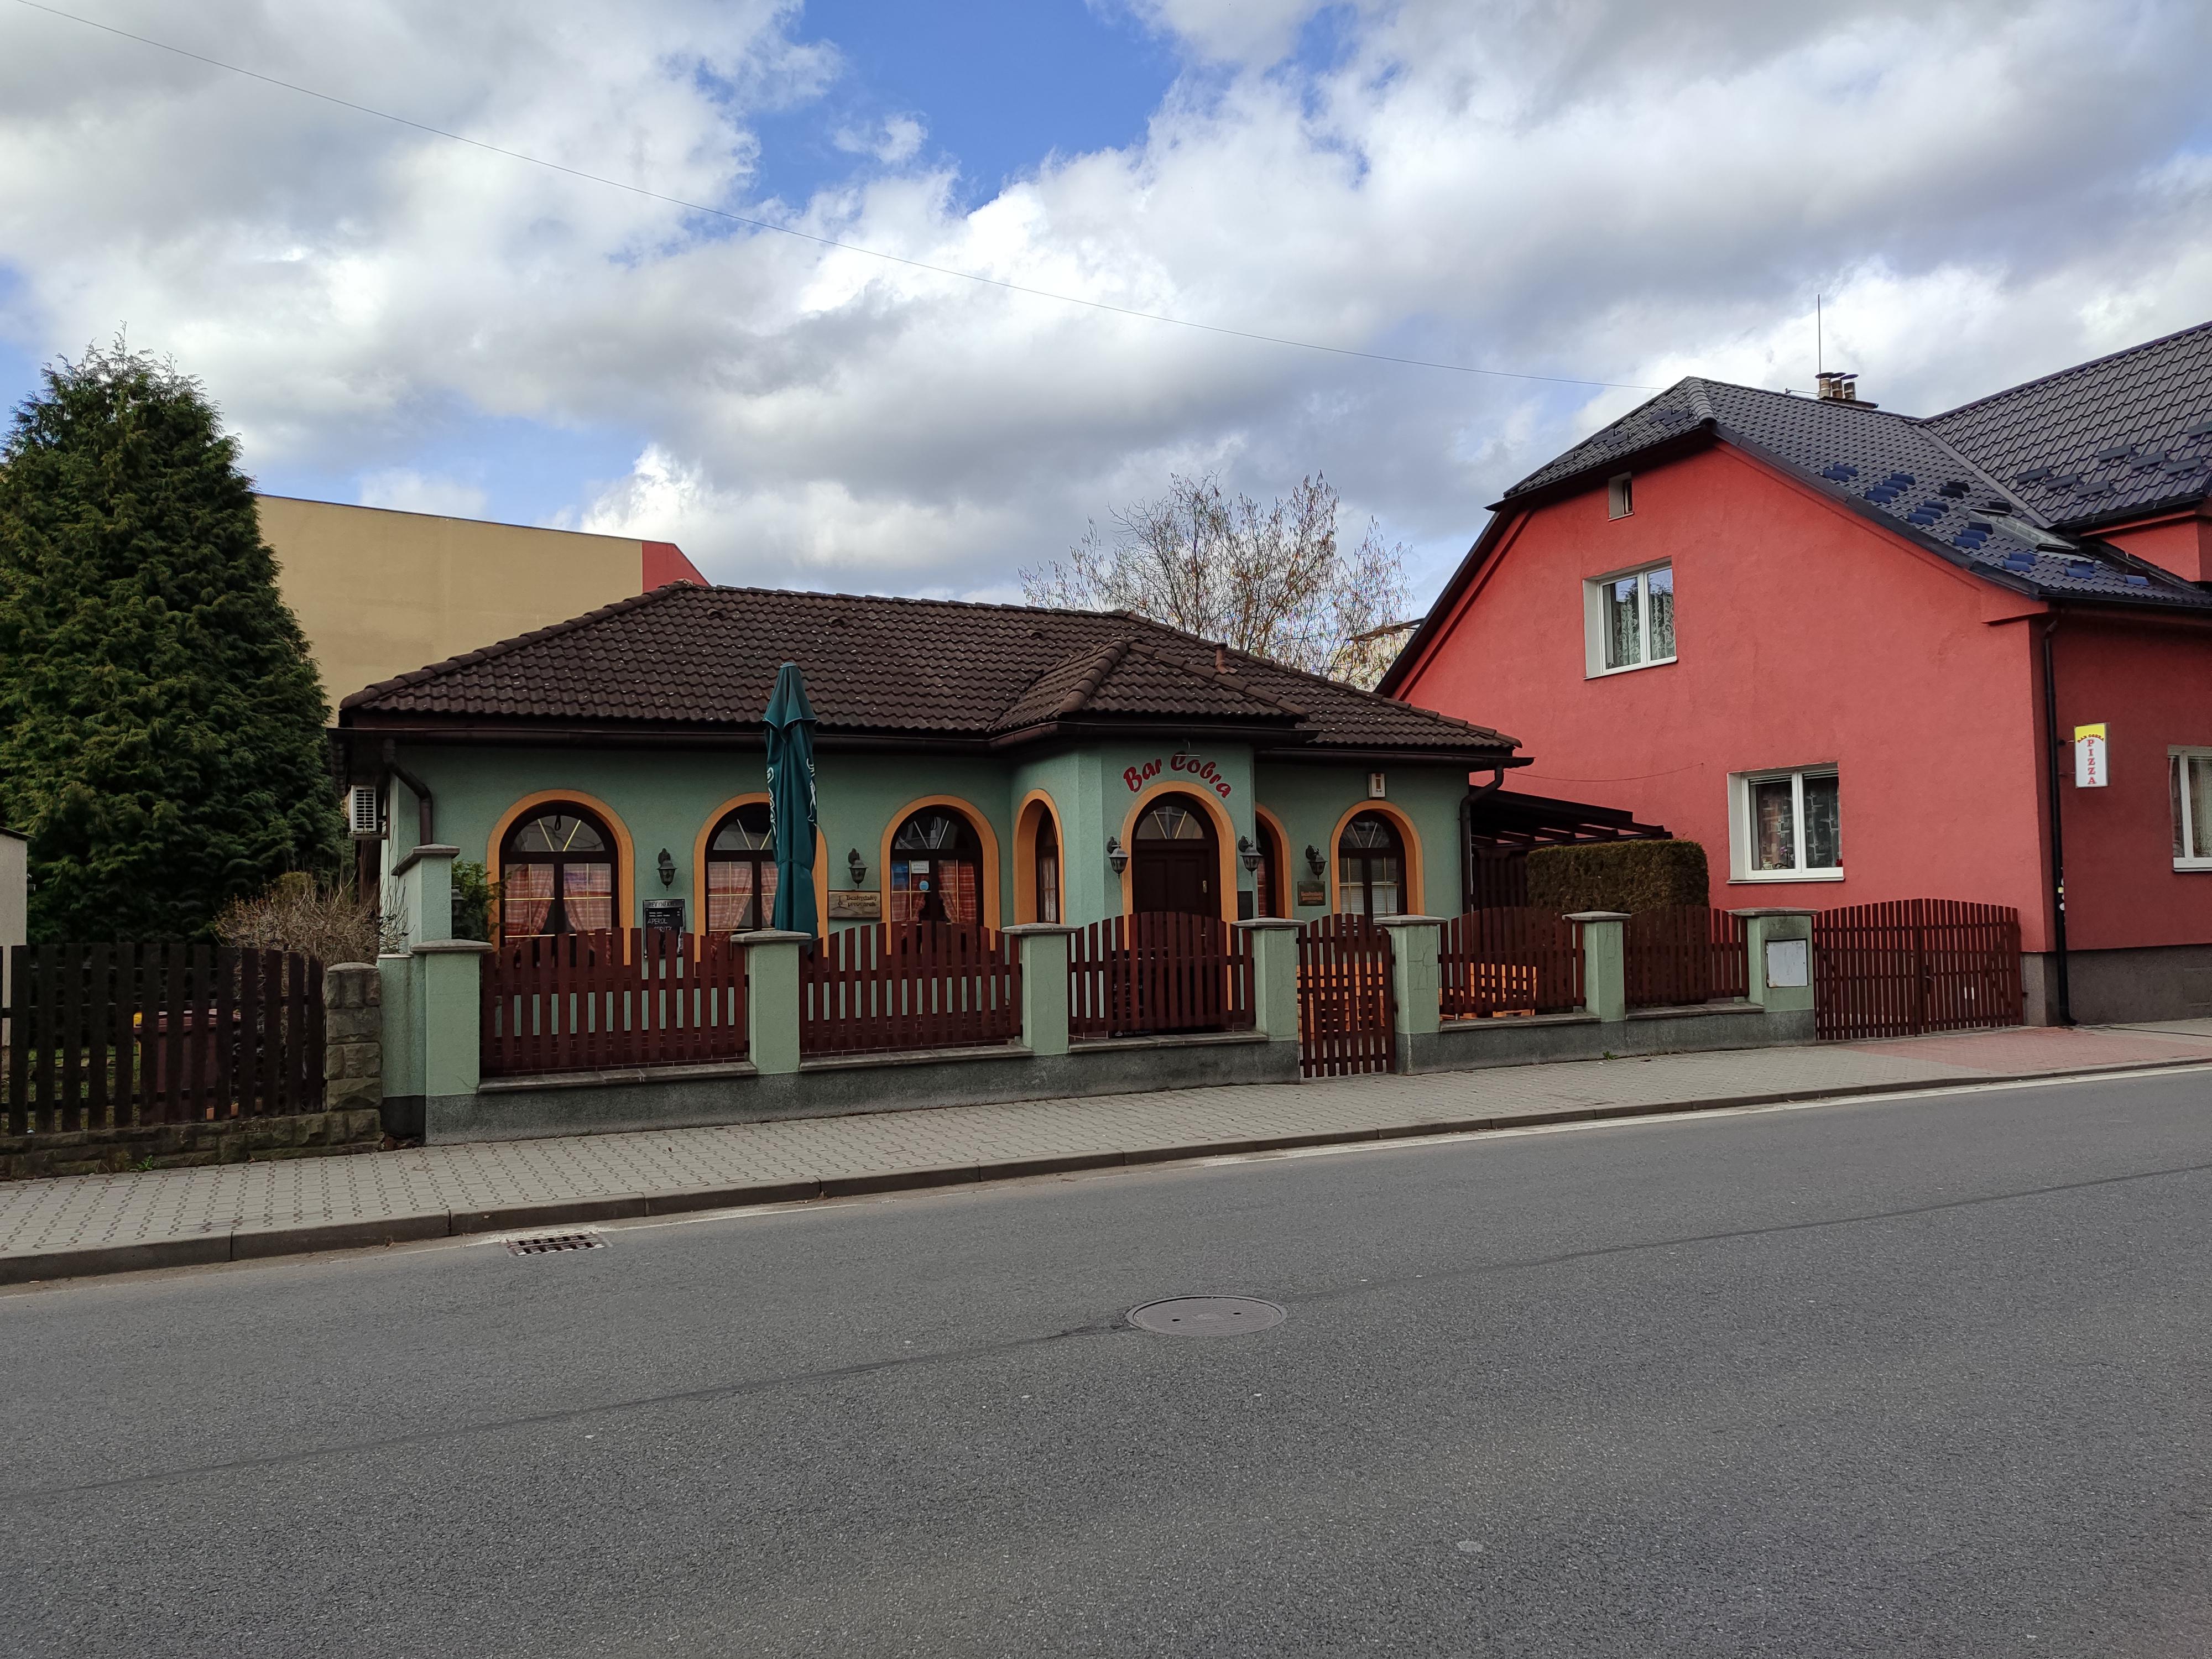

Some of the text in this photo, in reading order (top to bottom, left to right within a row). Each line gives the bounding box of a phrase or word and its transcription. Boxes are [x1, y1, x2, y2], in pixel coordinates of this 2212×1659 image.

[1123, 750, 1232, 799] Bar Cobra
[2086, 738, 2097, 785] PIZZA
